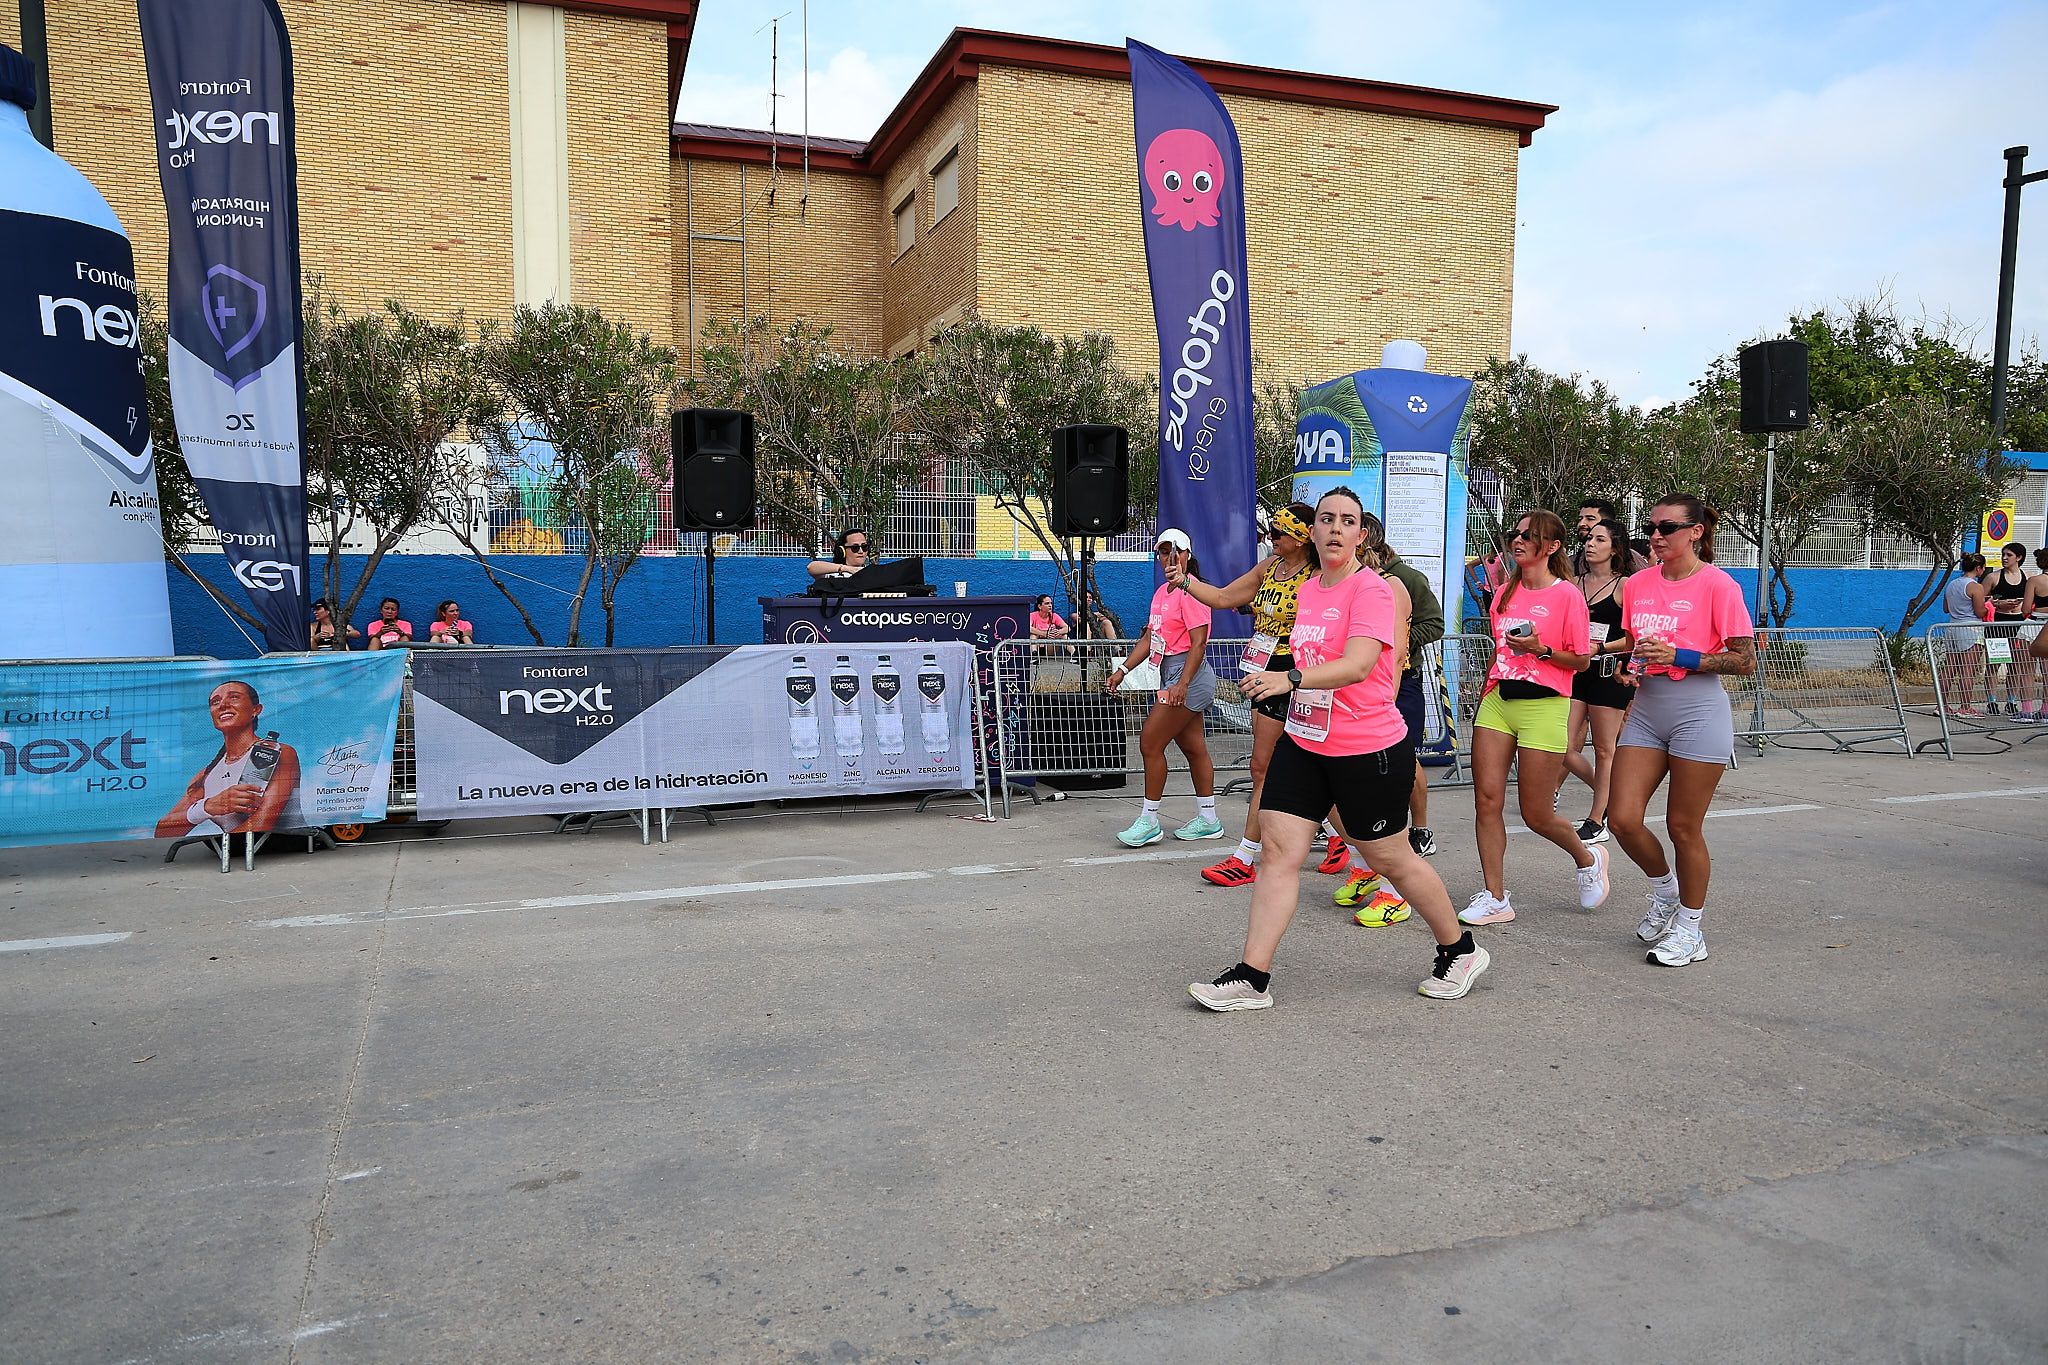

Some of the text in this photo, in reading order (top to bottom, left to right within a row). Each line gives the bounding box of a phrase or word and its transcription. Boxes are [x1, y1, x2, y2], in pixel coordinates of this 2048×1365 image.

[840, 610, 972, 630] octopus energy
[1629, 612, 1679, 633] CARRERA
[523, 665, 588, 678] Fontarel
[499, 681, 613, 715] next
[4, 706, 111, 724] Fontarel
[788, 772, 828, 780] MAGNESIO
[876, 768, 911, 776] ALCALINA
[917, 765, 960, 774] ZERO SODIO
[316, 787, 346, 795] Marta
[458, 769, 768, 801] La nueva era de la hidratación
